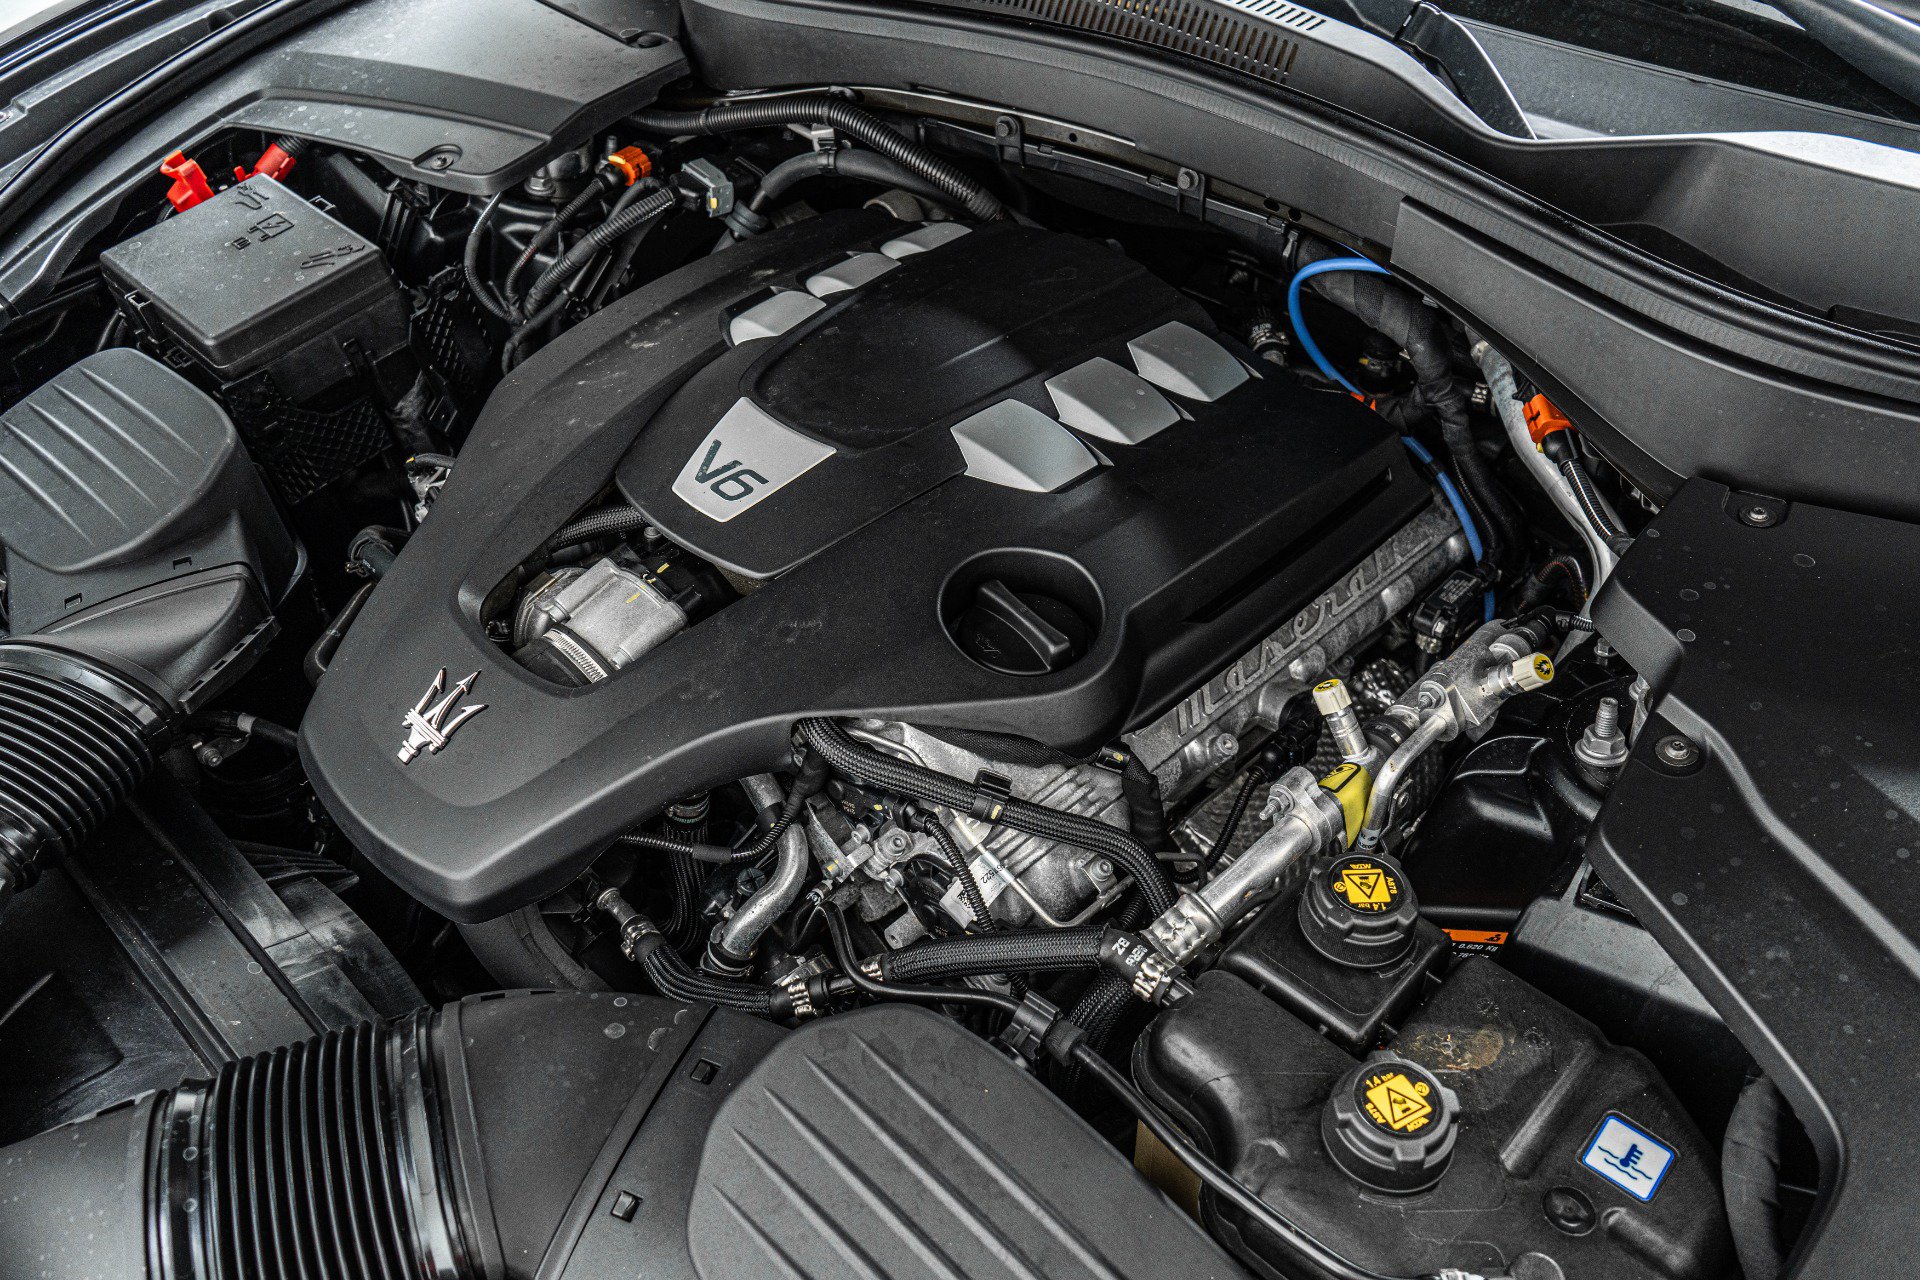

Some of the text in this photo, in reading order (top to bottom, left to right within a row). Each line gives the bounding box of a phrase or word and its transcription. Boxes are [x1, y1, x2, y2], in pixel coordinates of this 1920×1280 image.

[695, 439, 769, 501] V6
[1373, 903, 1386, 911] 1.4
[1366, 1072, 1394, 1088] 1.4 bar
